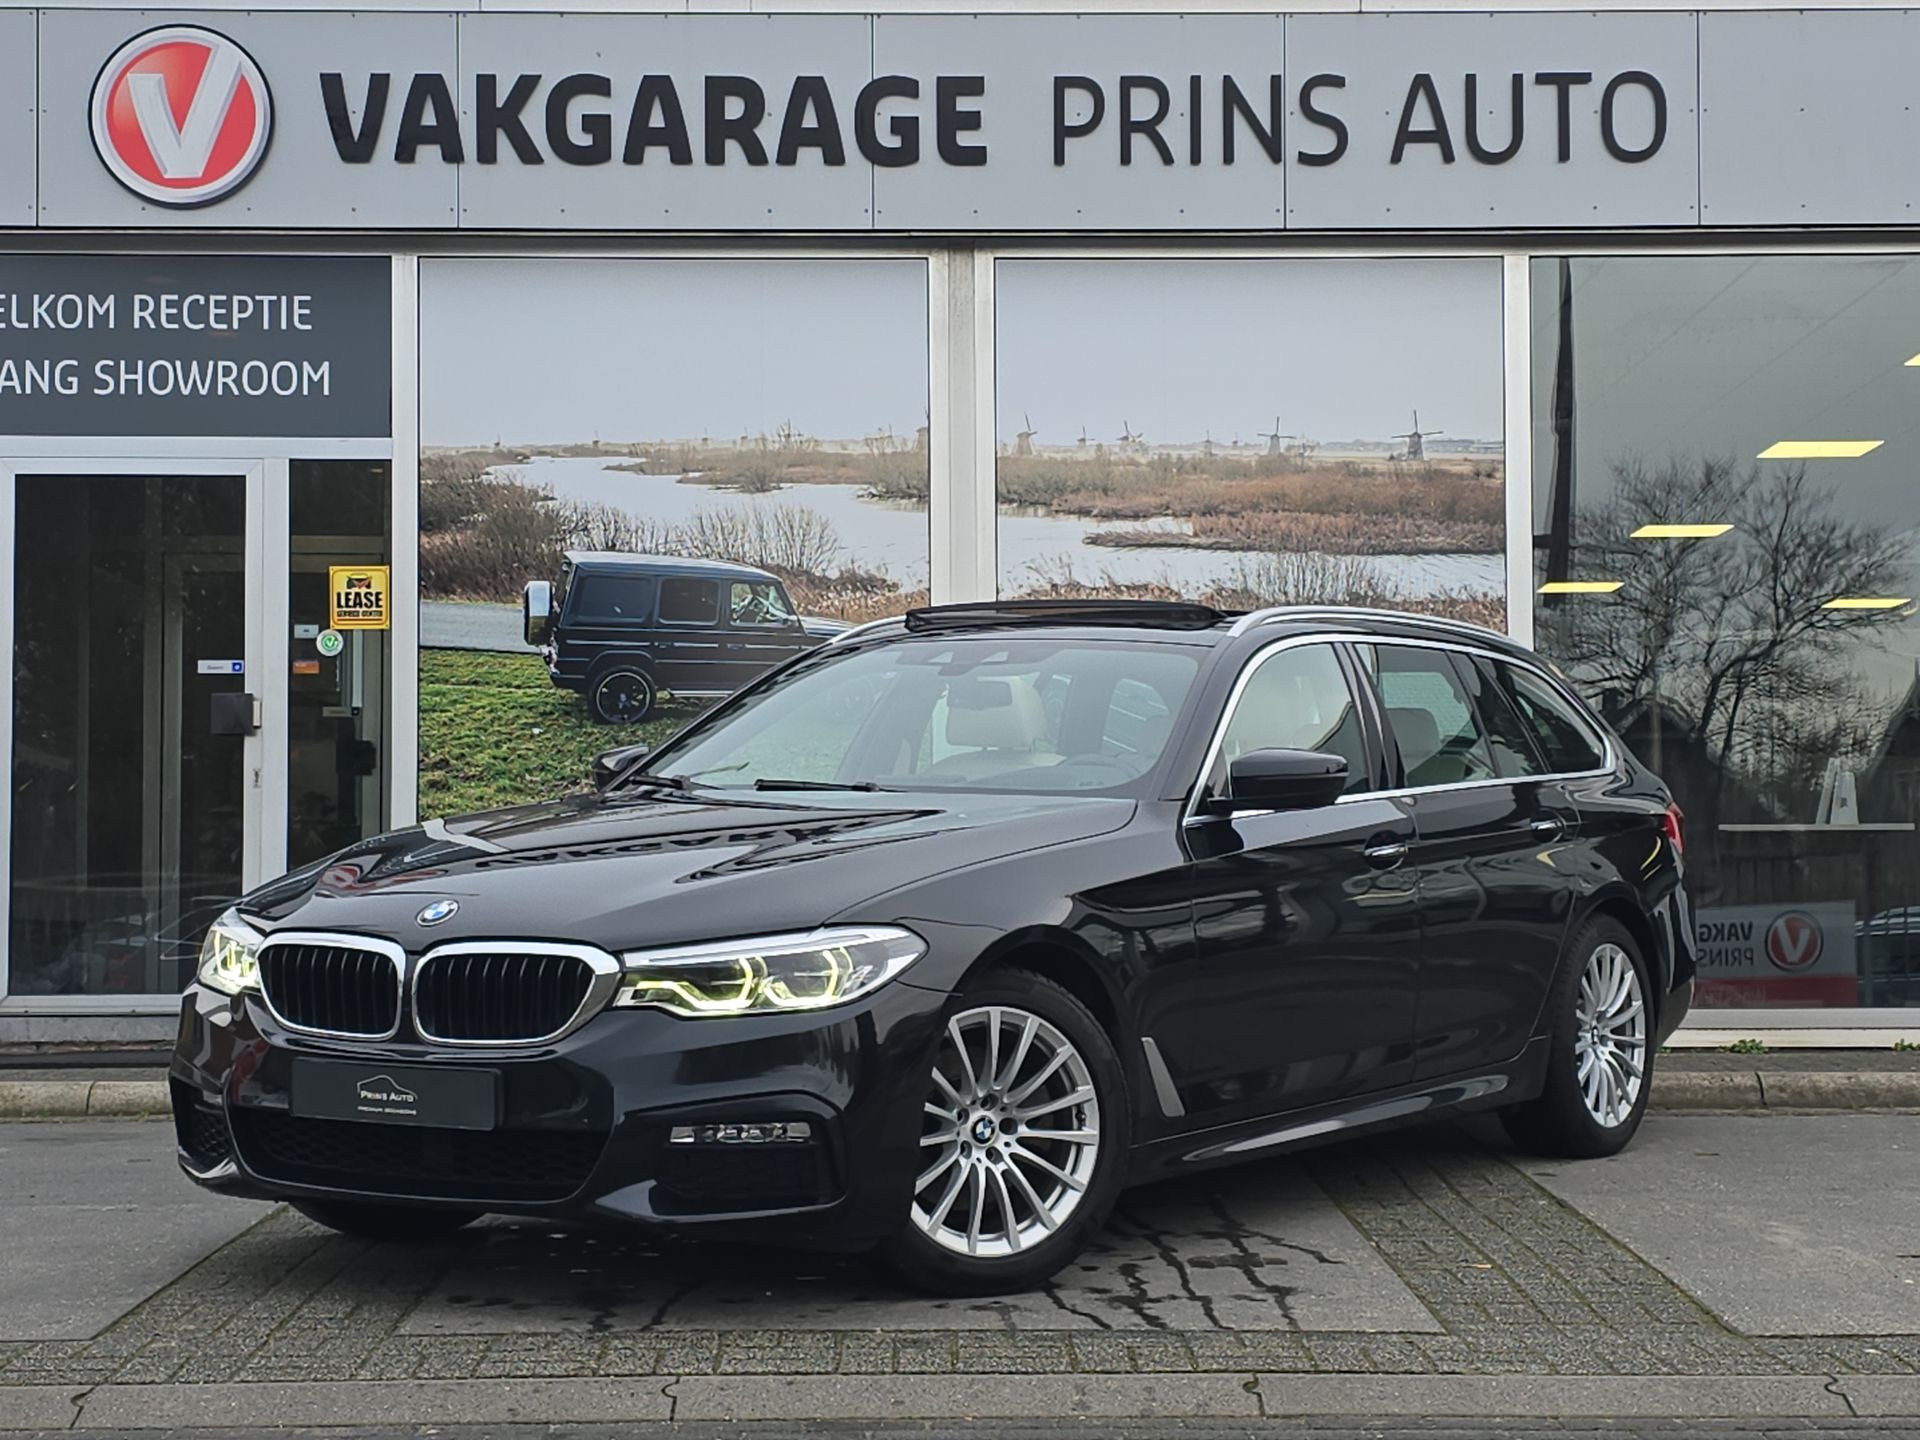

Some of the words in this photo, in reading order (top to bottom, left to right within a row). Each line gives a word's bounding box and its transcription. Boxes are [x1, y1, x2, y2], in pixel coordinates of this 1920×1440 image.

[319, 72, 988, 167] VAKGARAGE
[1053, 74, 1350, 167] PRINS
[1390, 70, 1667, 166] AUTO
[133, 294, 313, 330] RECEPTIE
[0, 359, 79, 395] ANG
[93, 359, 331, 396] SHOWROOM
[336, 591, 383, 609] LEASE
